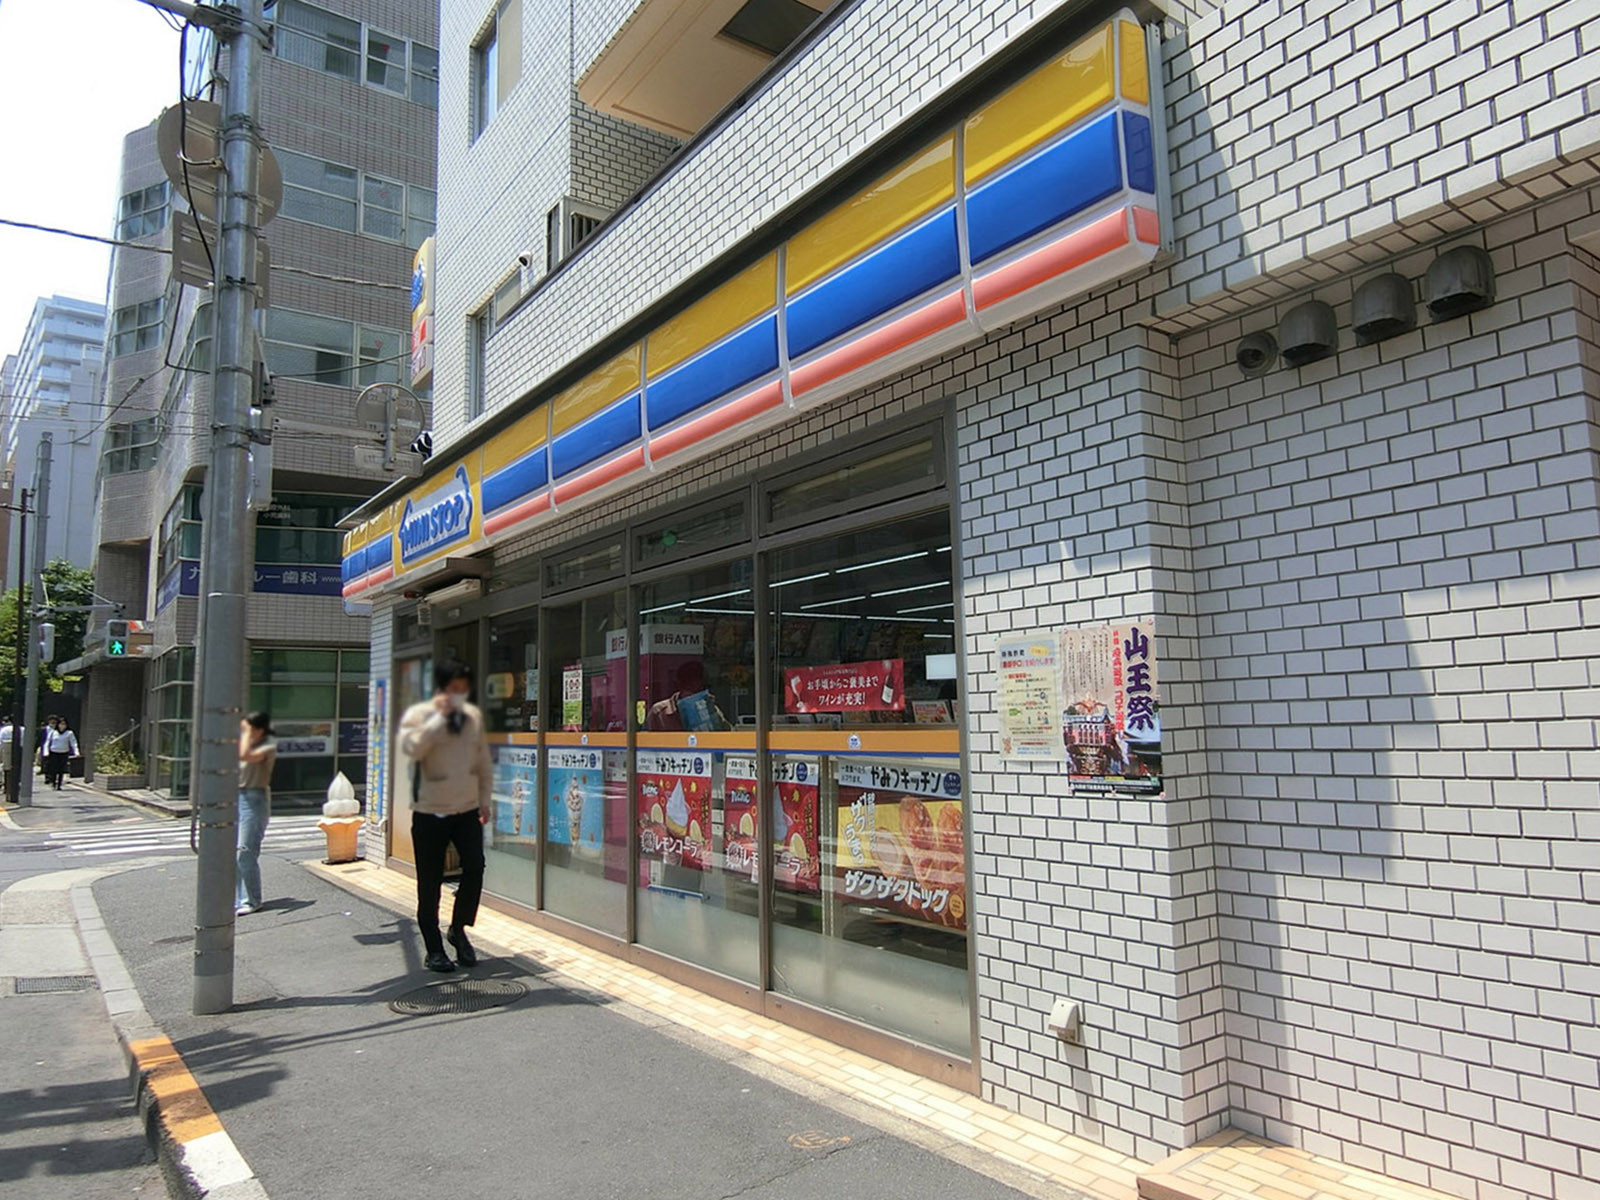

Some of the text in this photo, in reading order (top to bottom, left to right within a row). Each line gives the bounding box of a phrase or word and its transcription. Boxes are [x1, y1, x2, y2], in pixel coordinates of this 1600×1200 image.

[654, 633, 700, 645] 銀行ATM
[807, 676, 879, 690] お手頃からご褒美まで
[1124, 627, 1154, 731] 山王祭
[871, 766, 942, 793] やみつキッチン
